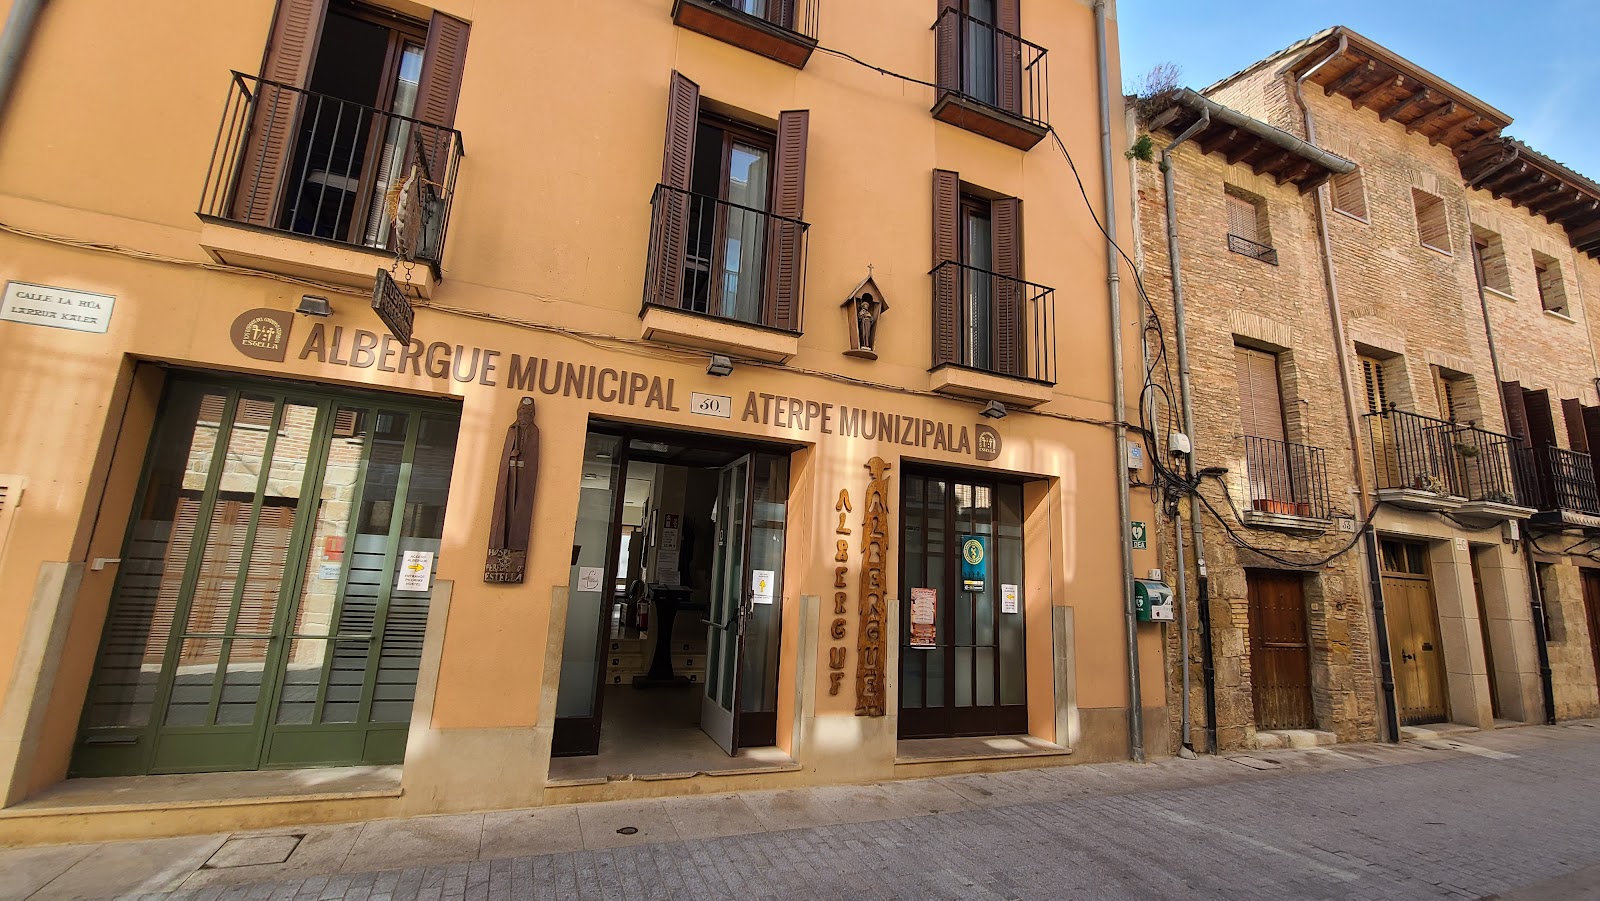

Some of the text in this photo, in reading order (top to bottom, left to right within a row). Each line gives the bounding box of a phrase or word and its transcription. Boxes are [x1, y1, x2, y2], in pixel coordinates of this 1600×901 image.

[16, 291, 101, 310] CALLE LA RÚA
[10, 306, 98, 325] LARRUA KALEA
[298, 323, 501, 387] ALBERGUE
[507, 353, 681, 413] MUNICIPAL
[741, 391, 834, 435] ATERPE
[839, 405, 972, 455] MUNIZIPALA
[484, 573, 522, 581] ESTELLA
